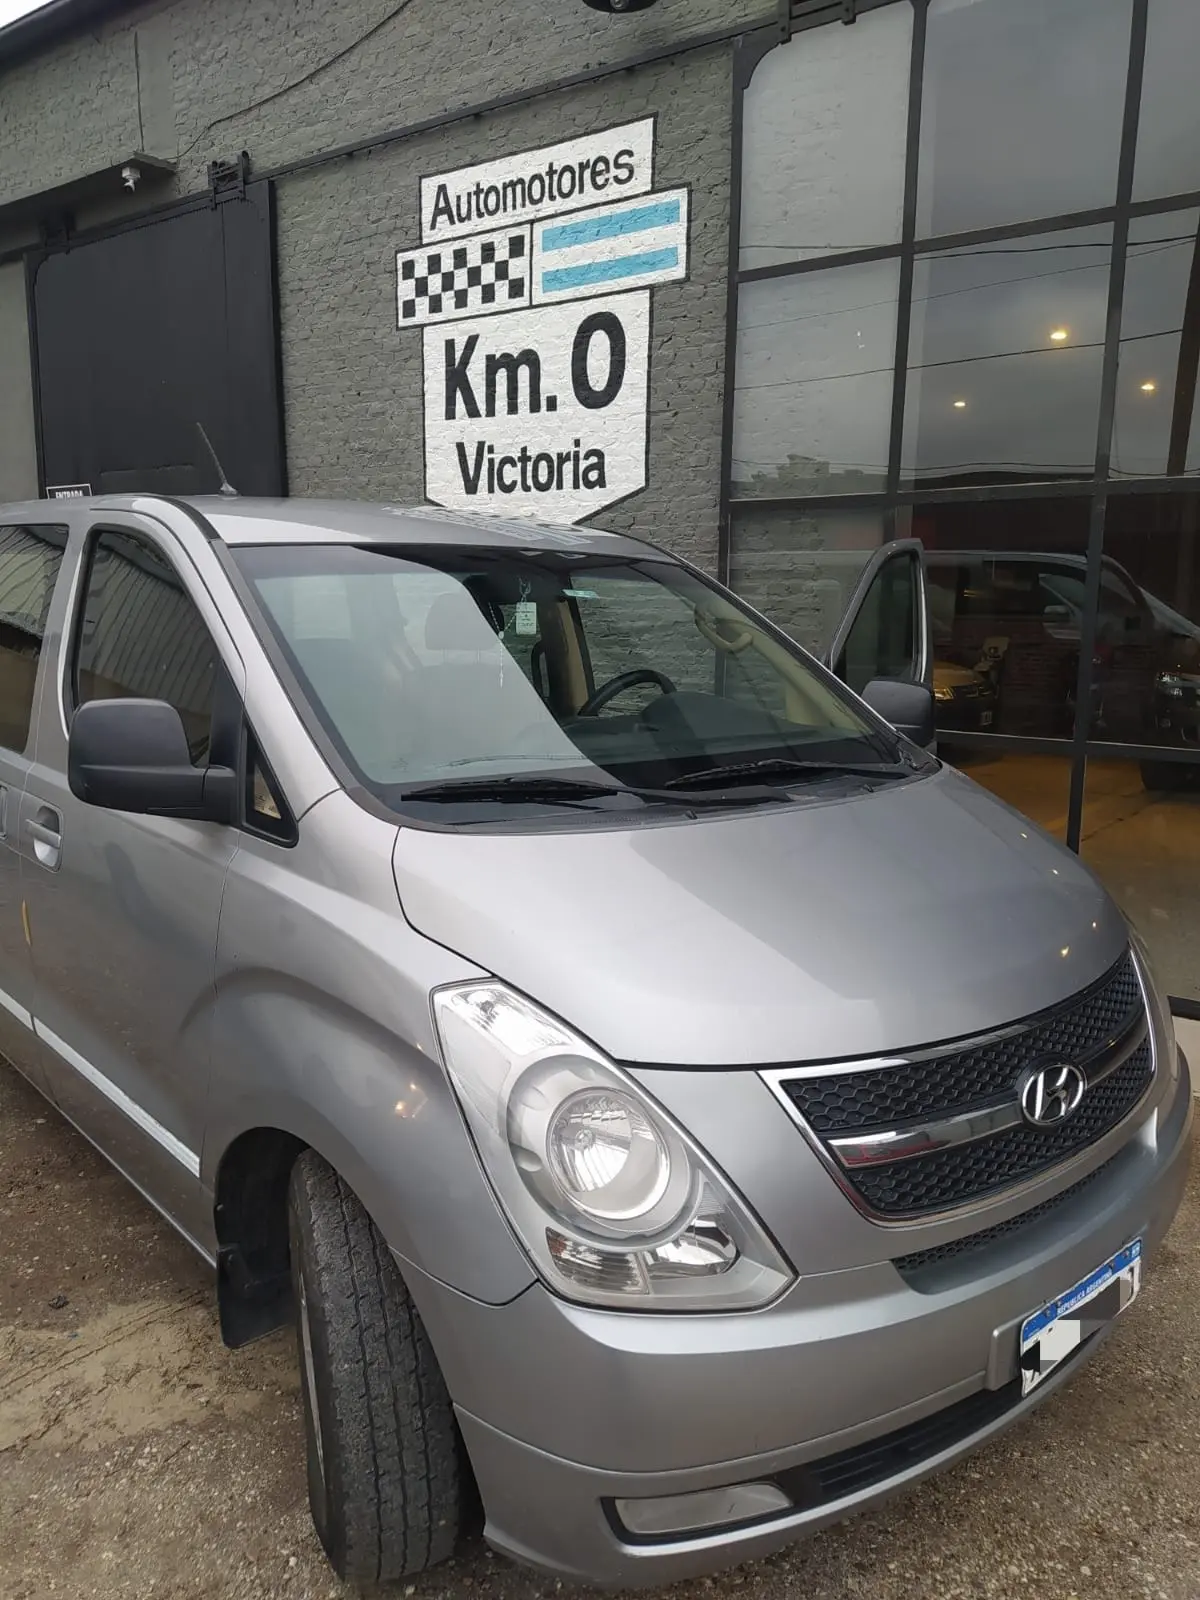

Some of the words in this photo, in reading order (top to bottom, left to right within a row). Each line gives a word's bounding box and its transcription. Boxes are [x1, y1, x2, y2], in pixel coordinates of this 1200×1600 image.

[429, 148, 635, 231] Automotores
[444, 333, 558, 421] Km.
[571, 311, 626, 410] 0
[455, 438, 607, 495] Victoria
